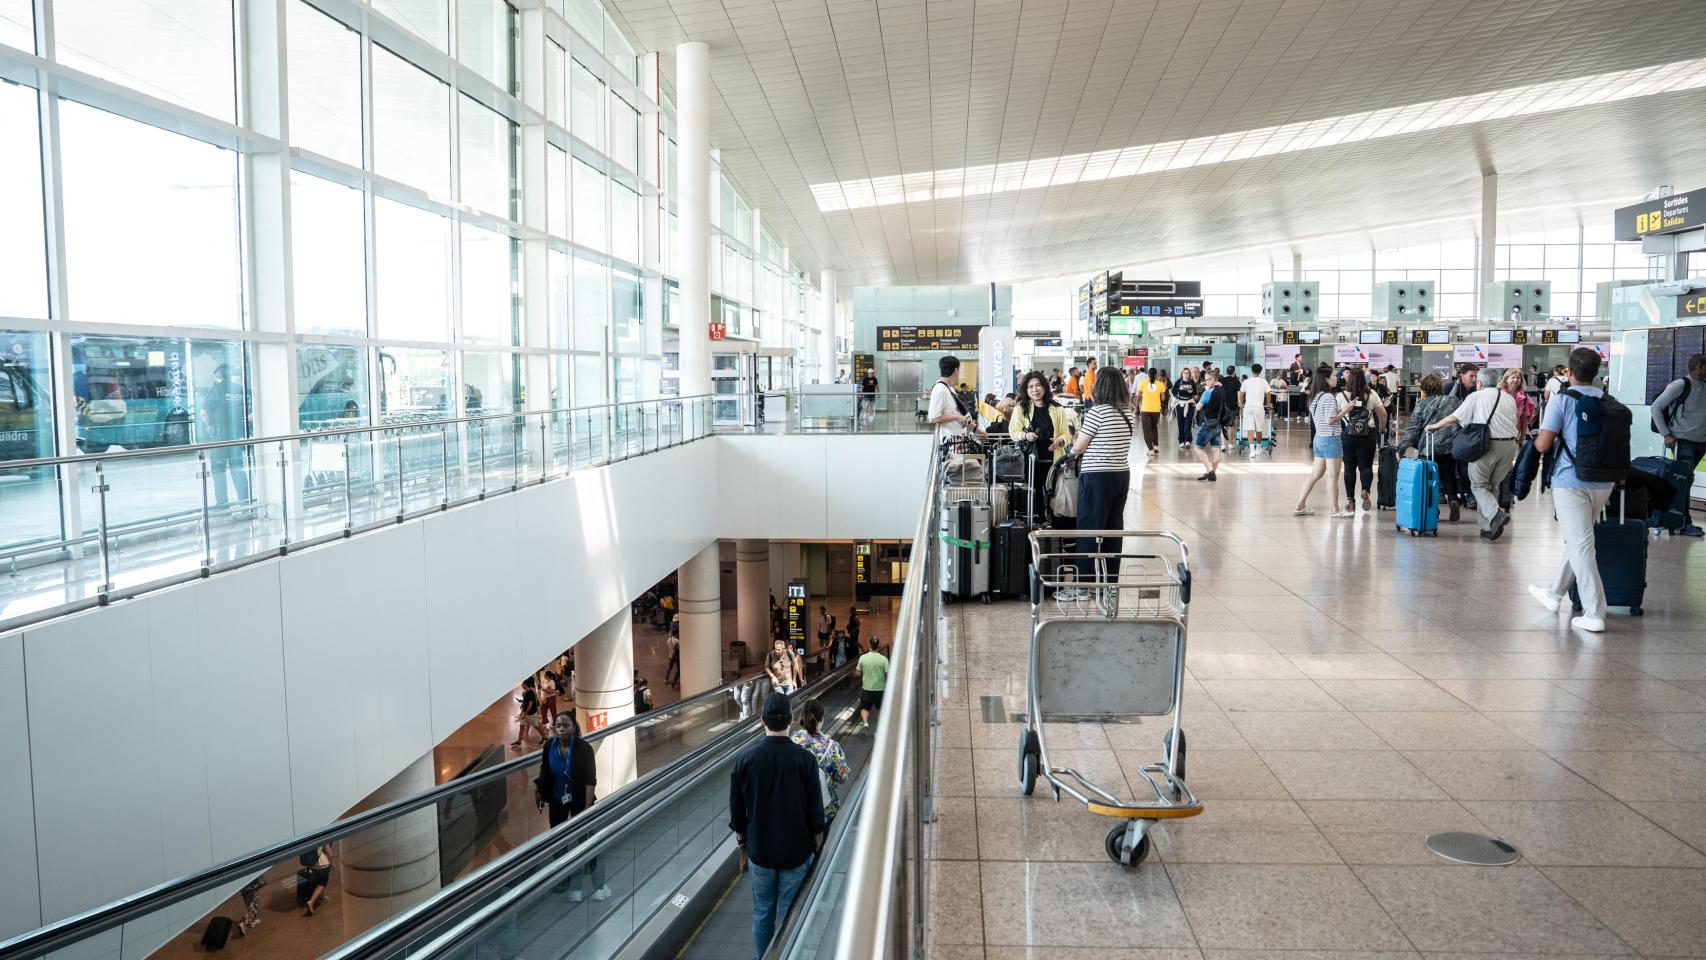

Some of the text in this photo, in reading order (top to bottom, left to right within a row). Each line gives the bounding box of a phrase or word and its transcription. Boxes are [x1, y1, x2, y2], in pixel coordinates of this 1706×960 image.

[1663, 196, 1689, 208] Sortides
[1663, 207, 1689, 218] Departures
[1663, 217, 1685, 228] Salidas
